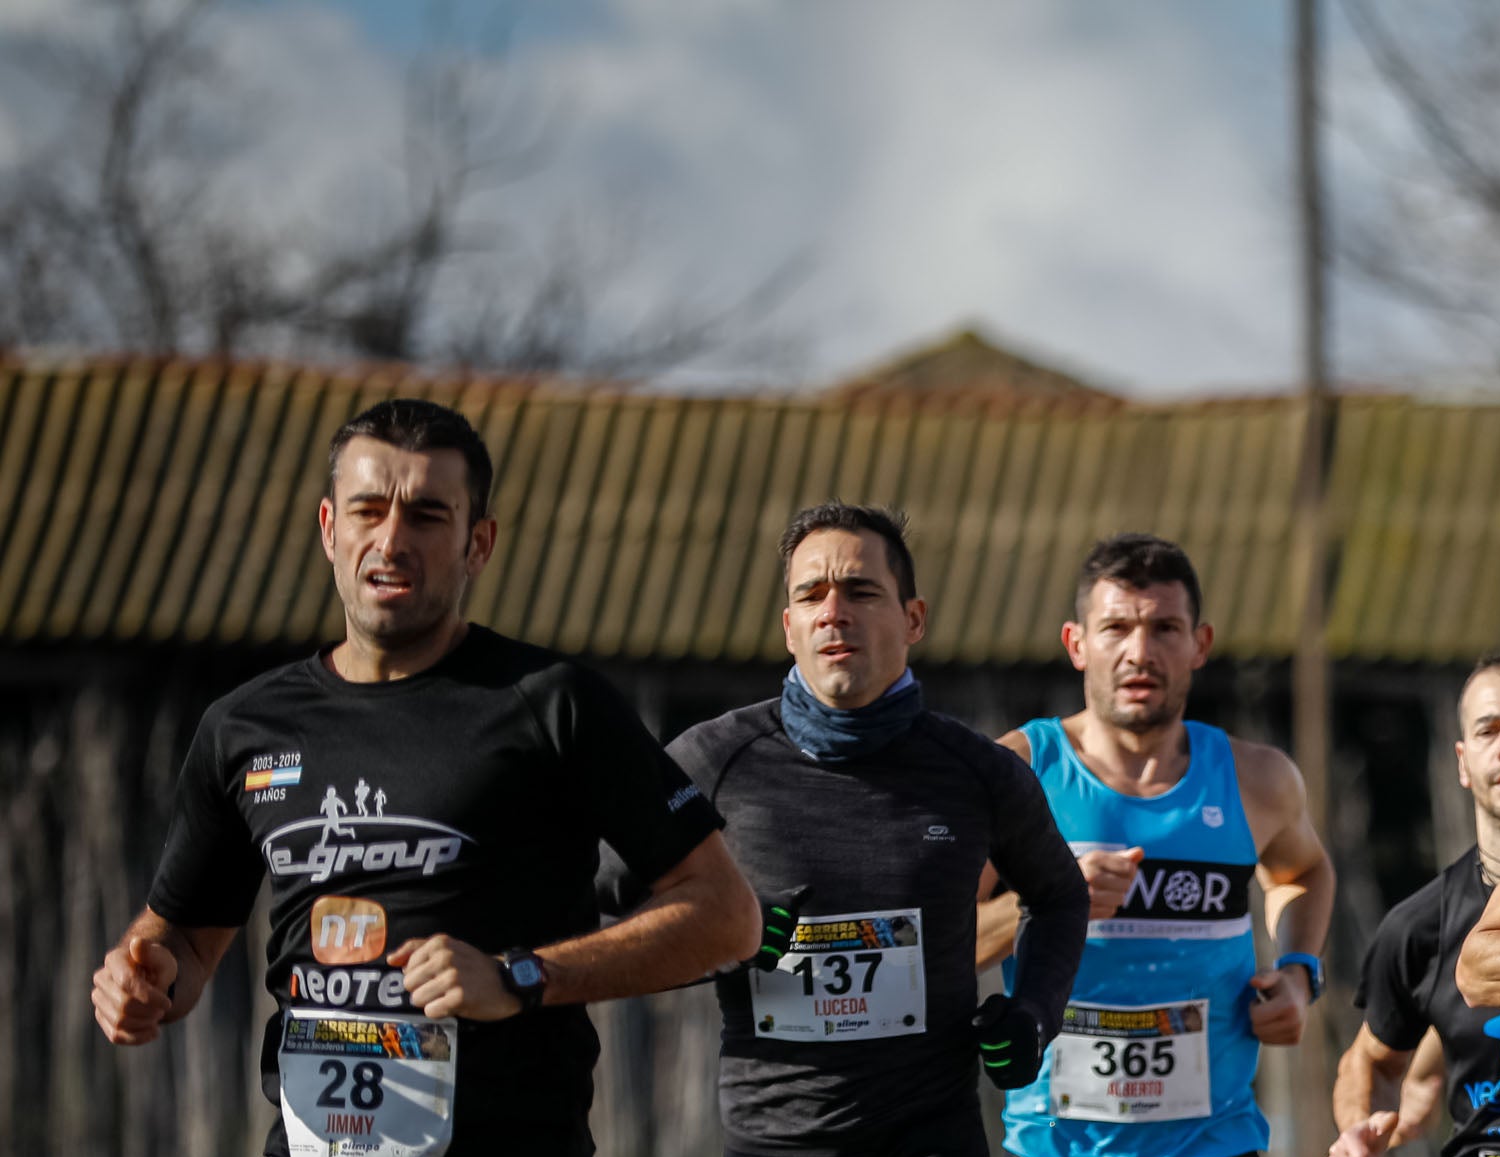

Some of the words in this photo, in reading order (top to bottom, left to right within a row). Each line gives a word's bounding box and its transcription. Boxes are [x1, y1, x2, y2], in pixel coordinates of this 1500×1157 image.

[262, 788, 286, 802] AÑOS
[796, 922, 858, 935] CARRERA
[792, 952, 883, 996] 137
[1091, 1040, 1175, 1077] 365
[315, 1059, 385, 1111] 28
[1107, 1080, 1165, 1098] ALBERTO
[325, 1113, 375, 1136] JIMMY
[342, 1140, 380, 1153] olimpo
